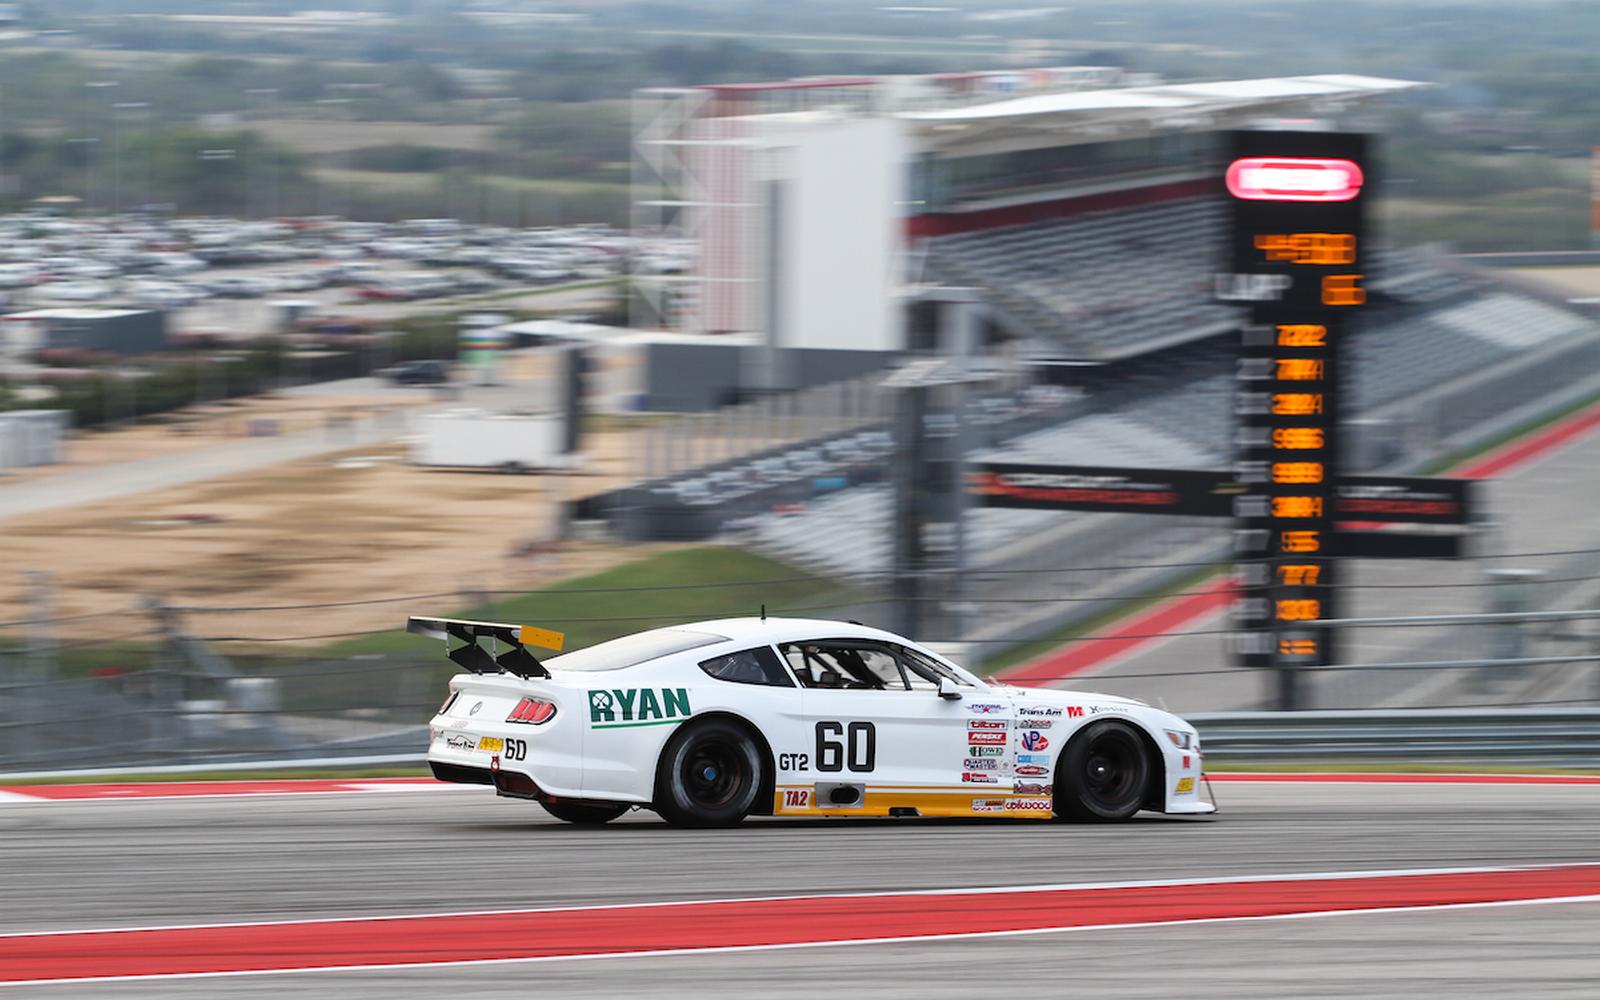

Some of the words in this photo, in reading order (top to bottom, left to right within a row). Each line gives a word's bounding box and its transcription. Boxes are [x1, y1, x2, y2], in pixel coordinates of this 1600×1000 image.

[588, 688, 692, 722] RYAN
[1045, 708, 1062, 716] Am
[970, 720, 1005, 729] tilton
[504, 737, 527, 761] 60
[815, 721, 876, 772] 60
[1022, 731, 1040, 751] VP
[780, 753, 808, 771] GT2
[786, 790, 808, 806] TA2
